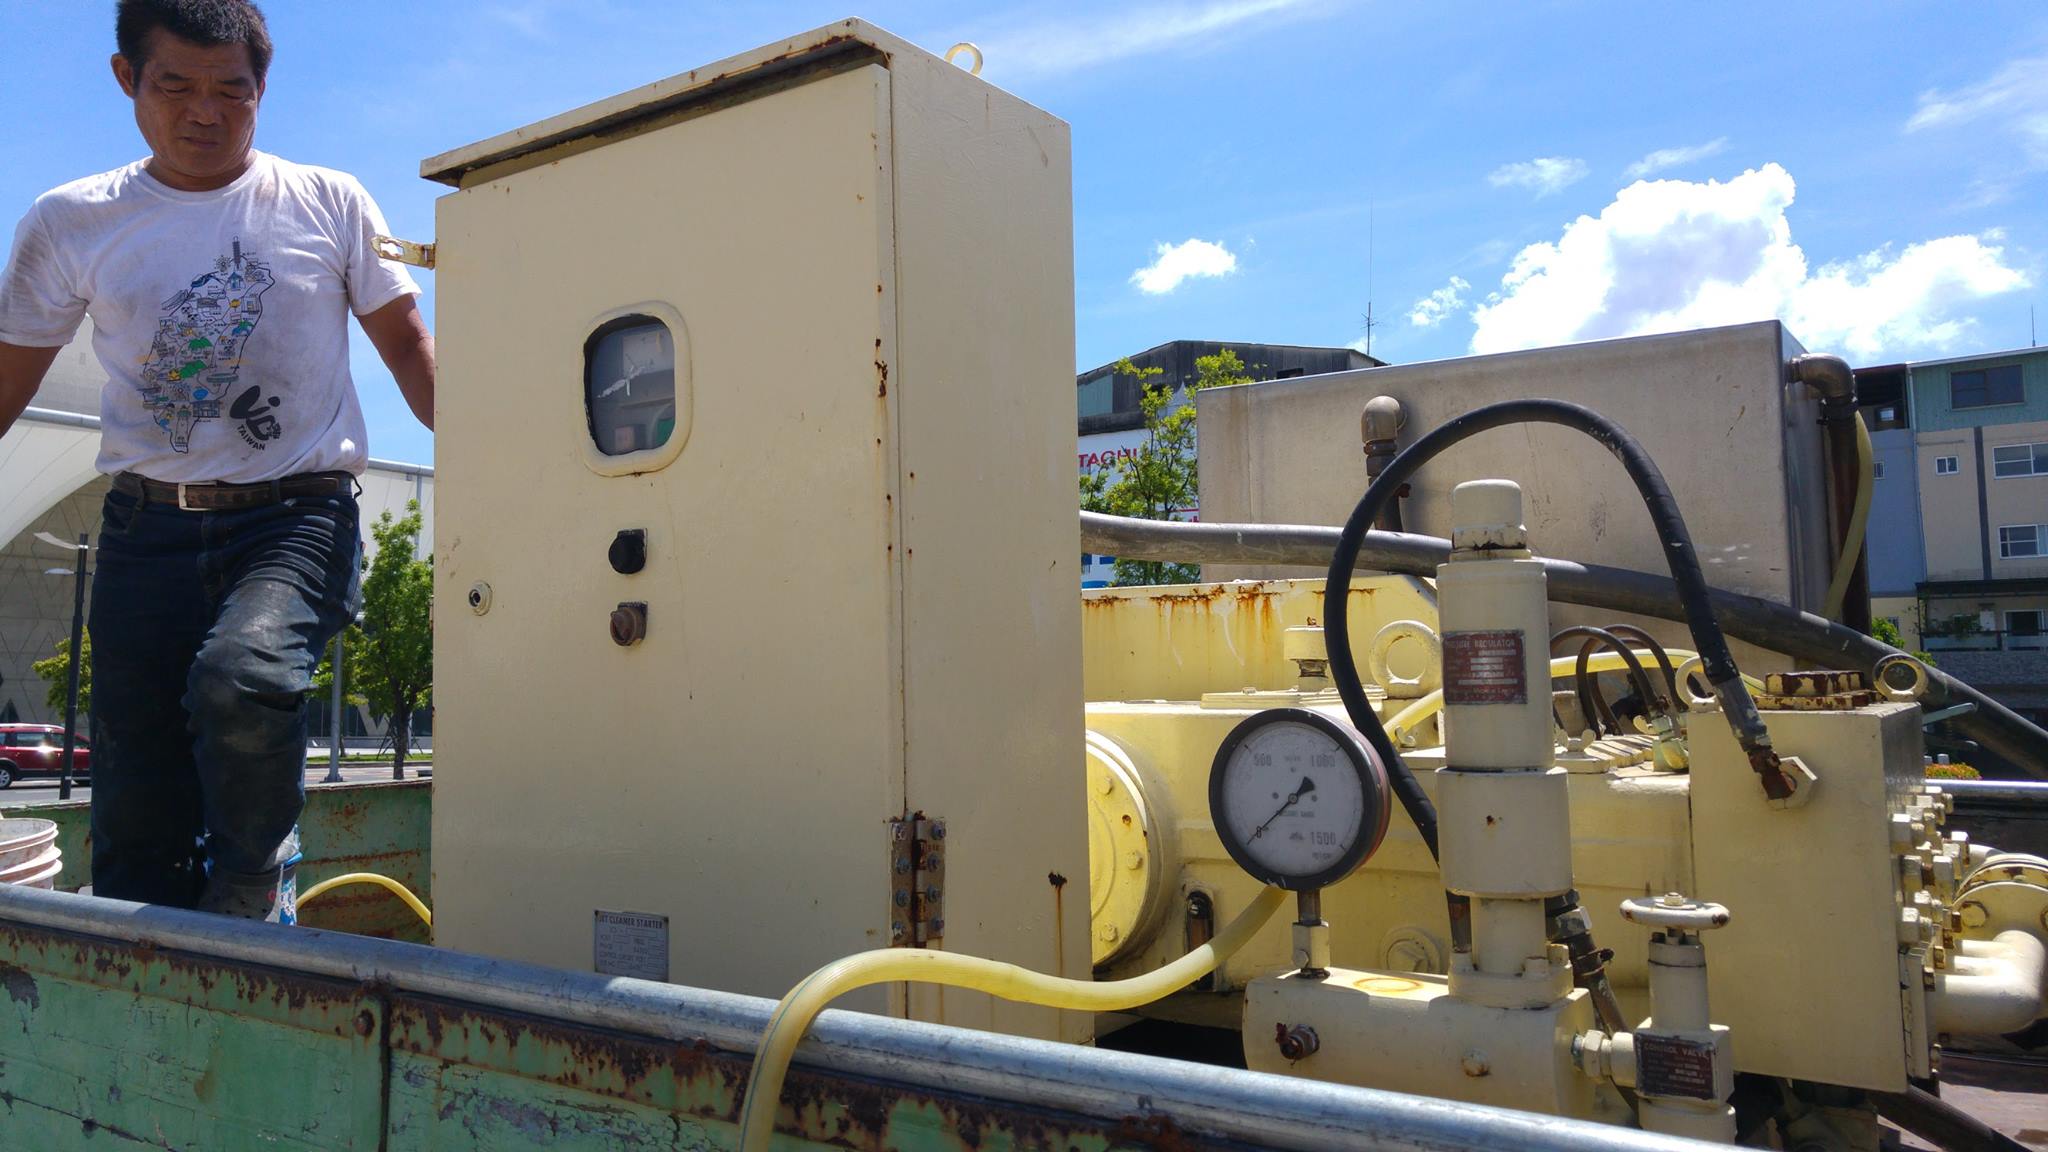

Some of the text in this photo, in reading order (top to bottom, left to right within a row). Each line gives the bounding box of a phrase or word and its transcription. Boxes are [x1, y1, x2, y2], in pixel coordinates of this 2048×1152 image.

[237, 423, 266, 451] TAIWAN
[1474, 639, 1516, 649] REGULATOR
[1254, 754, 1272, 767] 500
[1310, 754, 1336, 768] 1000
[1310, 831, 1336, 846] 1500
[609, 916, 635, 926] CLEANER
[636, 918, 663, 928] STARTER
